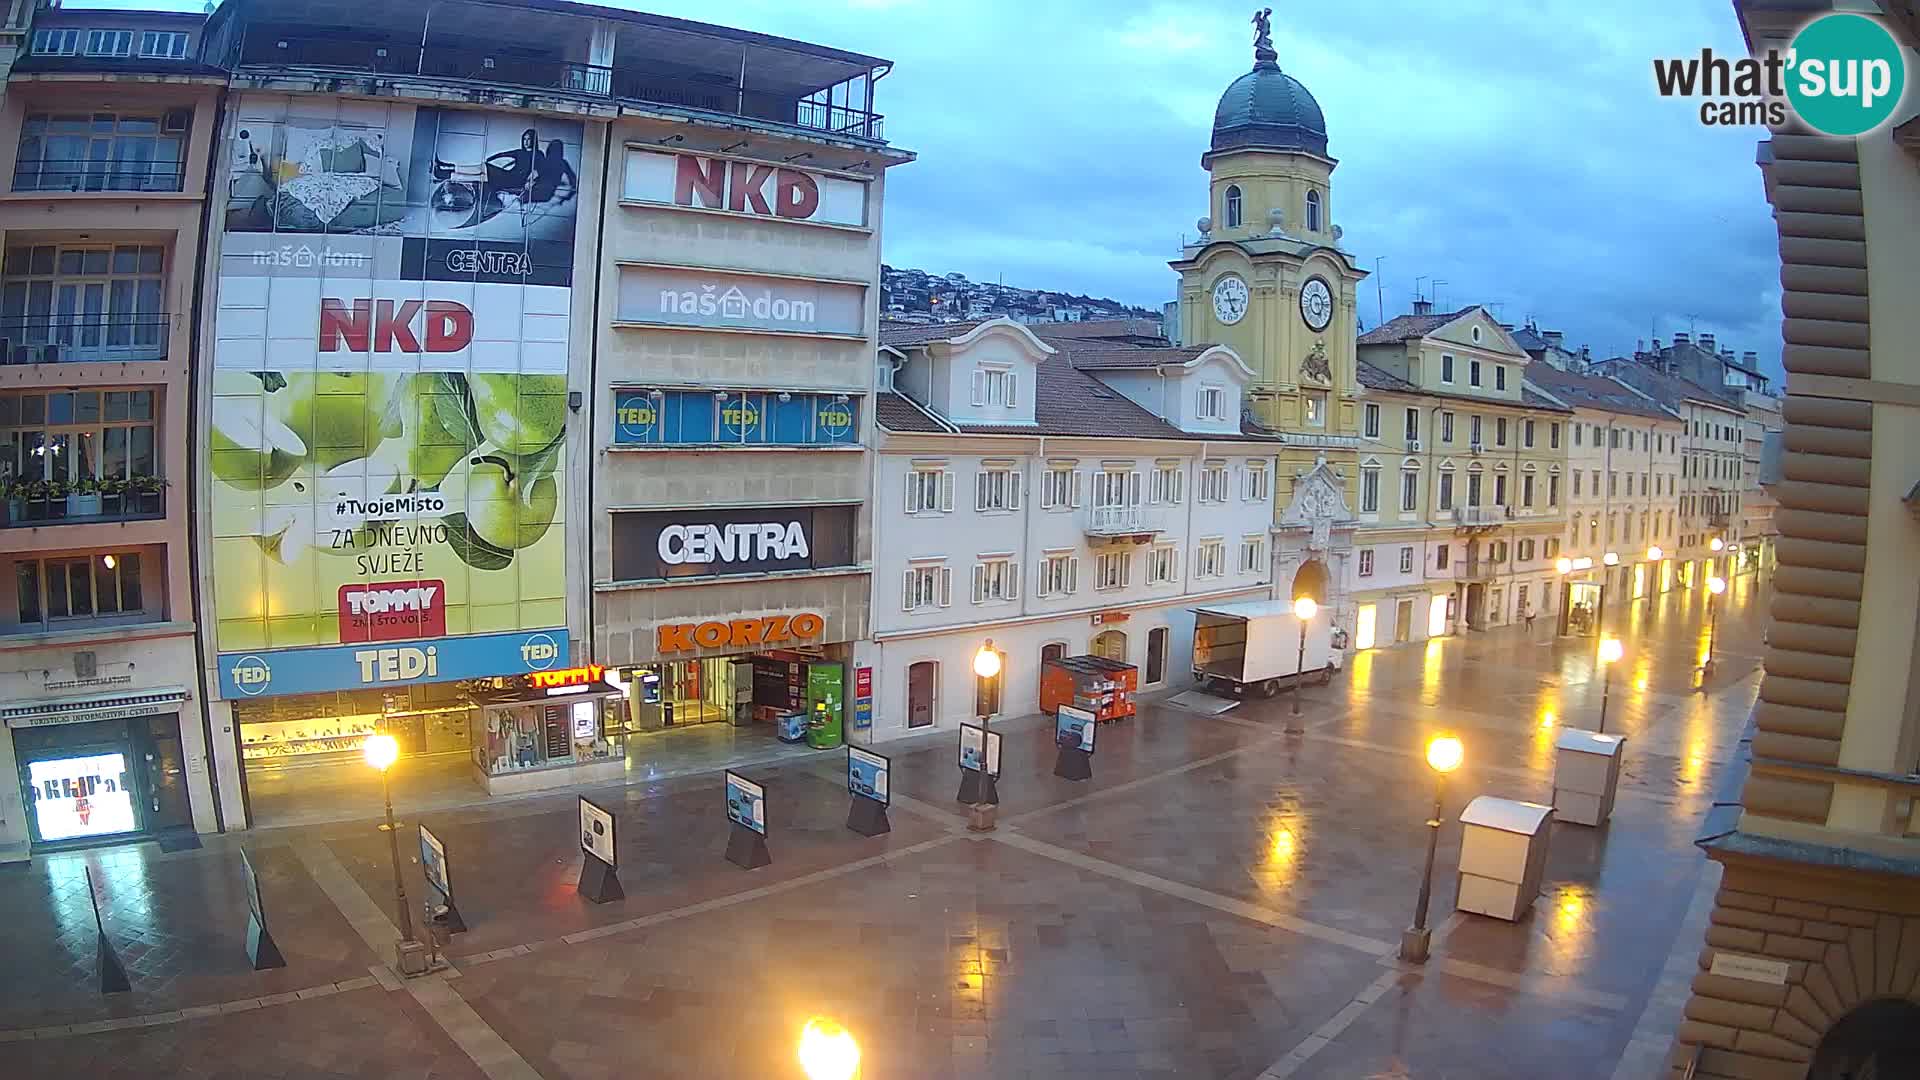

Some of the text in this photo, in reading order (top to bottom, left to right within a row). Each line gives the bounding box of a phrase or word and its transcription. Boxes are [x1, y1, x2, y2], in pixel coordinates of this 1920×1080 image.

[675, 154, 819, 219] NKD
[253, 244, 364, 268] naš dom
[446, 249, 533, 275] CENTRA
[660, 284, 815, 323] naš dom
[319, 298, 475, 353] NKD
[617, 407, 656, 425] TEDi
[722, 408, 759, 426] TEDi
[819, 410, 852, 427] TEDi
[336, 498, 444, 517] #TvojeMisto
[331, 524, 449, 549] ZA DNEVNO
[658, 520, 809, 565] CENTRA
[357, 548, 424, 575] SVJEŽE
[346, 586, 437, 615] TOMMY
[658, 613, 824, 653] KORZO
[355, 647, 439, 683] TEDi
[521, 643, 558, 662] TEDi
[231, 666, 272, 684] TEDi
[531, 664, 606, 688] TOMMY
